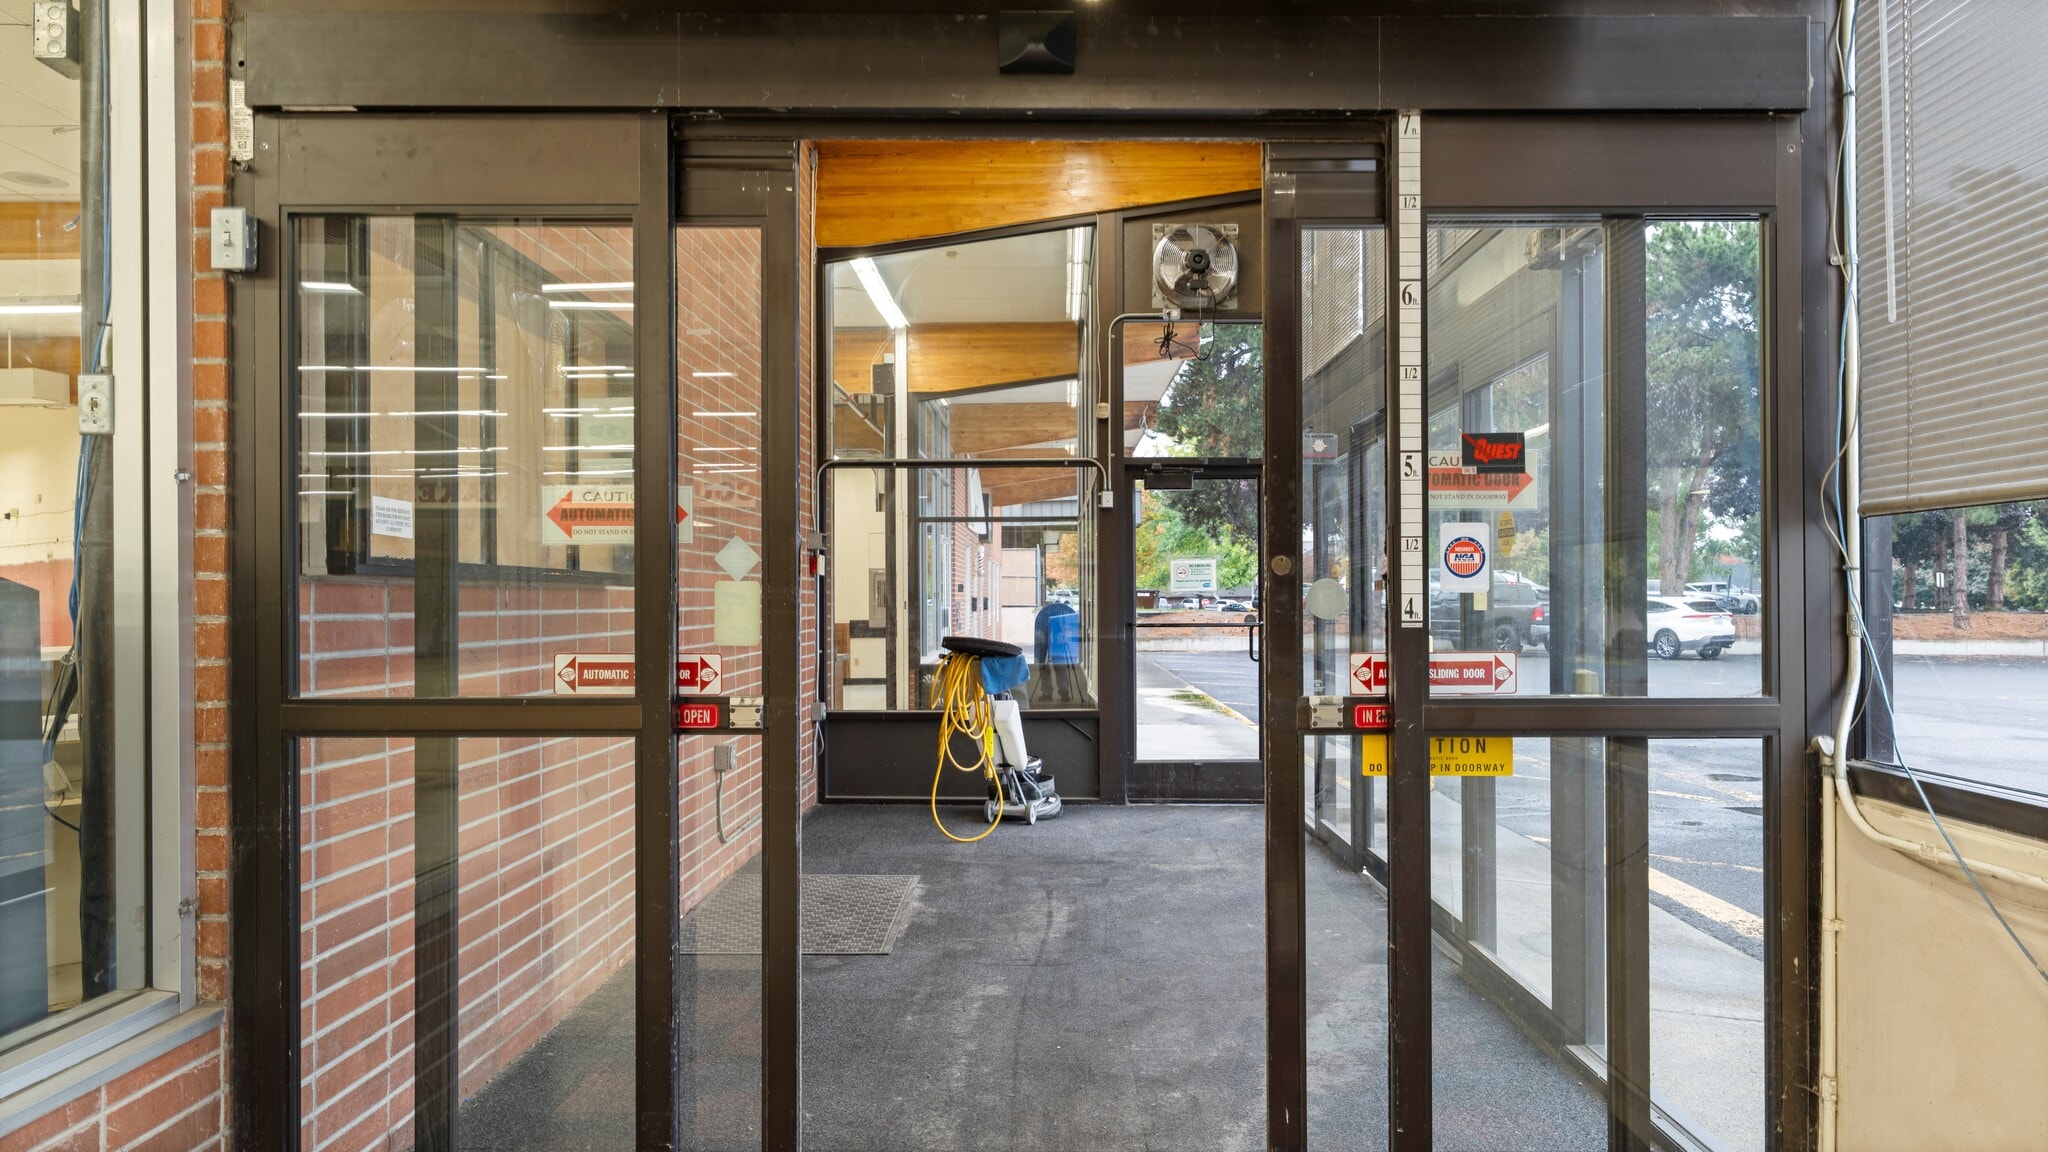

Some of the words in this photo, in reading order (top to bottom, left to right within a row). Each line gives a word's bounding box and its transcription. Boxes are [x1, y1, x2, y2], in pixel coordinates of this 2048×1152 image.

[1400, 114, 1411, 136] 7
[1402, 196, 1417, 208] 1/2
[1401, 283, 1413, 306] 6
[1403, 367, 1418, 379] 1/2
[1473, 438, 1523, 464] QUEST
[1404, 455, 1413, 477] 5
[1485, 473, 1520, 487] DOOR
[560, 507, 634, 522] AUTOMATIC
[1404, 538, 1419, 550] 1/2
[1454, 553, 1475, 562] NGA
[1404, 597, 1414, 619] 4
[582, 669, 629, 680] AUTOMATIC
[1429, 668, 1459, 679] SLIDING
[1463, 668, 1485, 679] DOOR
[683, 710, 711, 724] OPEN
[1362, 709, 1373, 724] IN
[1369, 764, 1383, 772] DO
[1440, 764, 1451, 772] IN
[1455, 764, 1506, 772] DOORWAY
